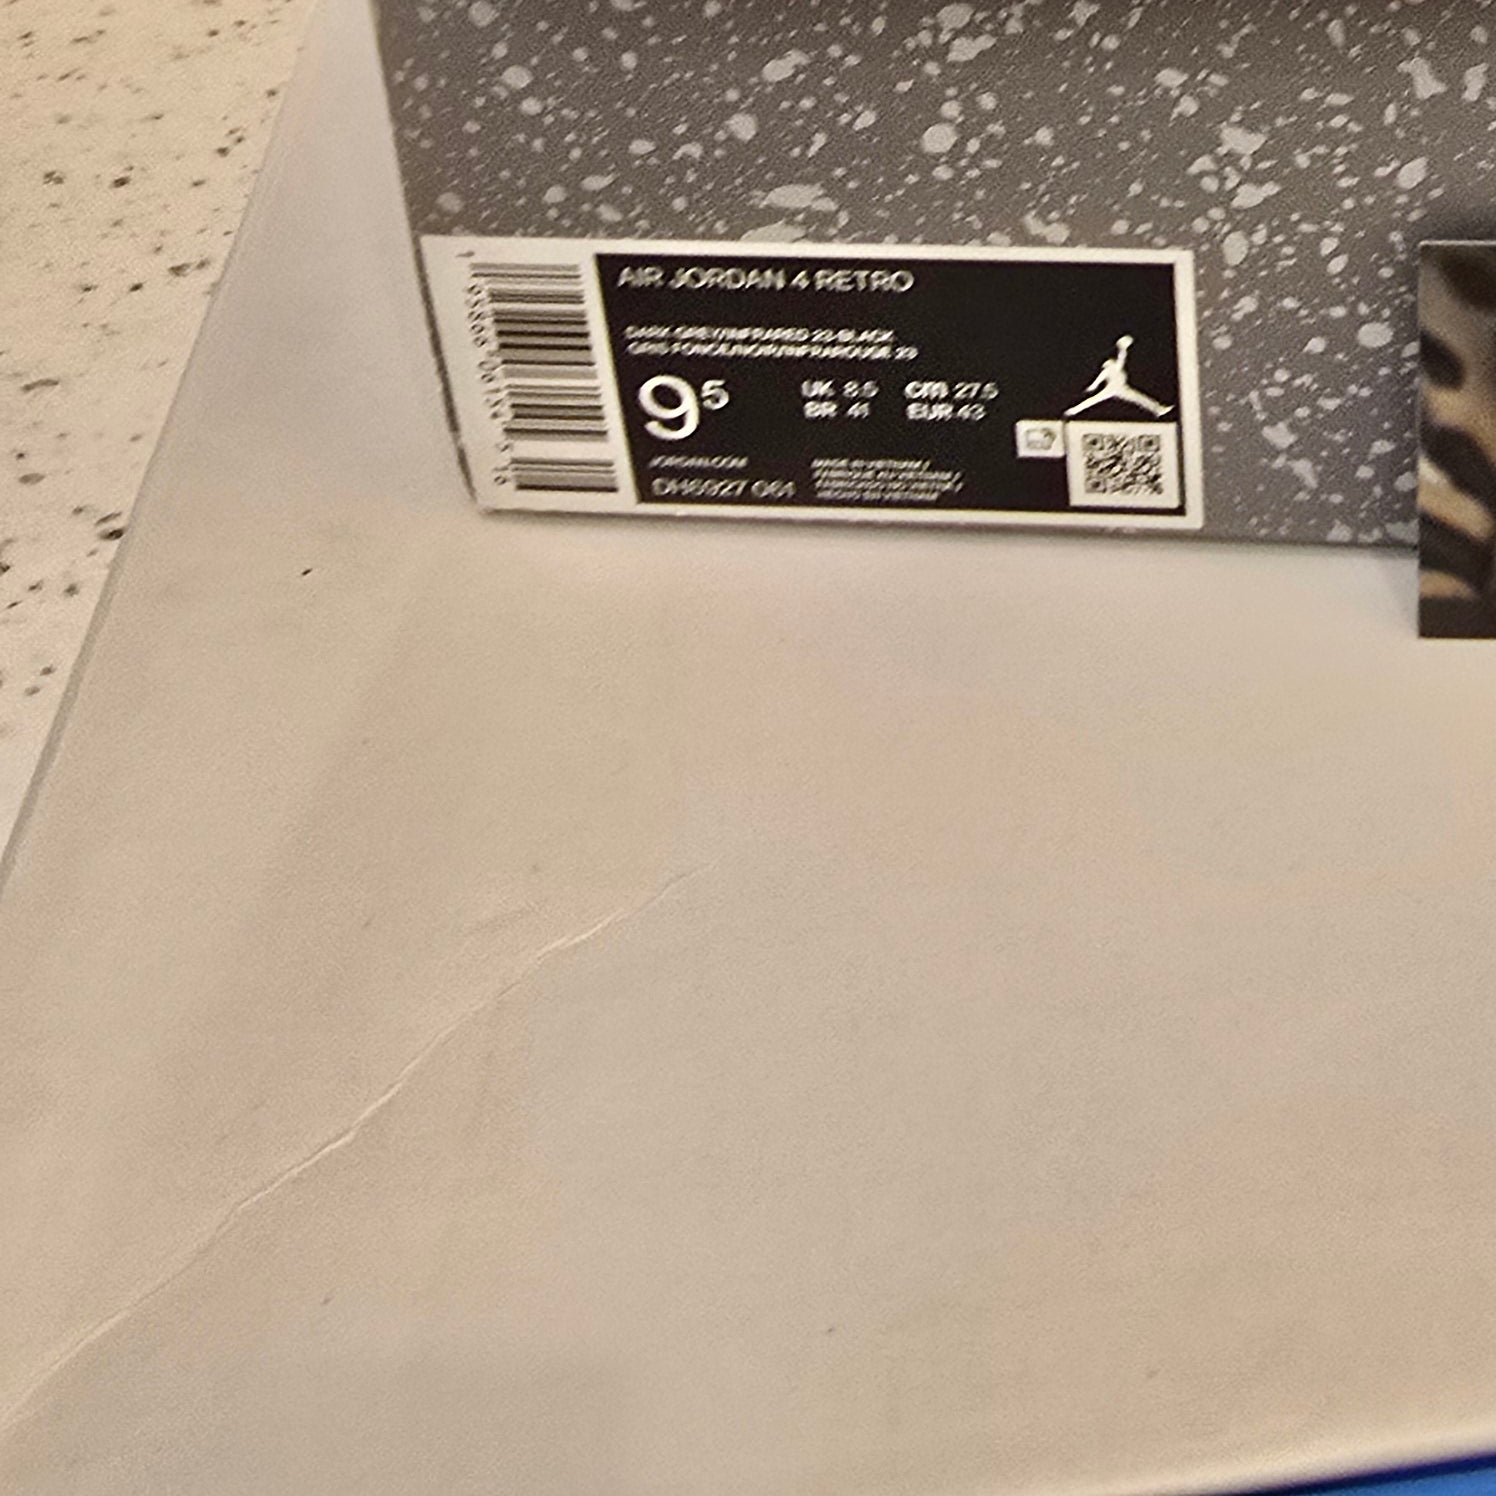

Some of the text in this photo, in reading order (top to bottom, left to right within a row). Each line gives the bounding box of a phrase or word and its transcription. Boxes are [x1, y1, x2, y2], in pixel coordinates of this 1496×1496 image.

[617, 265, 916, 294] AIR JORDAN 4 RETRO
[801, 378, 836, 398] UK
[904, 380, 949, 400] CM
[803, 400, 987, 422] BR 41 EUR 43
